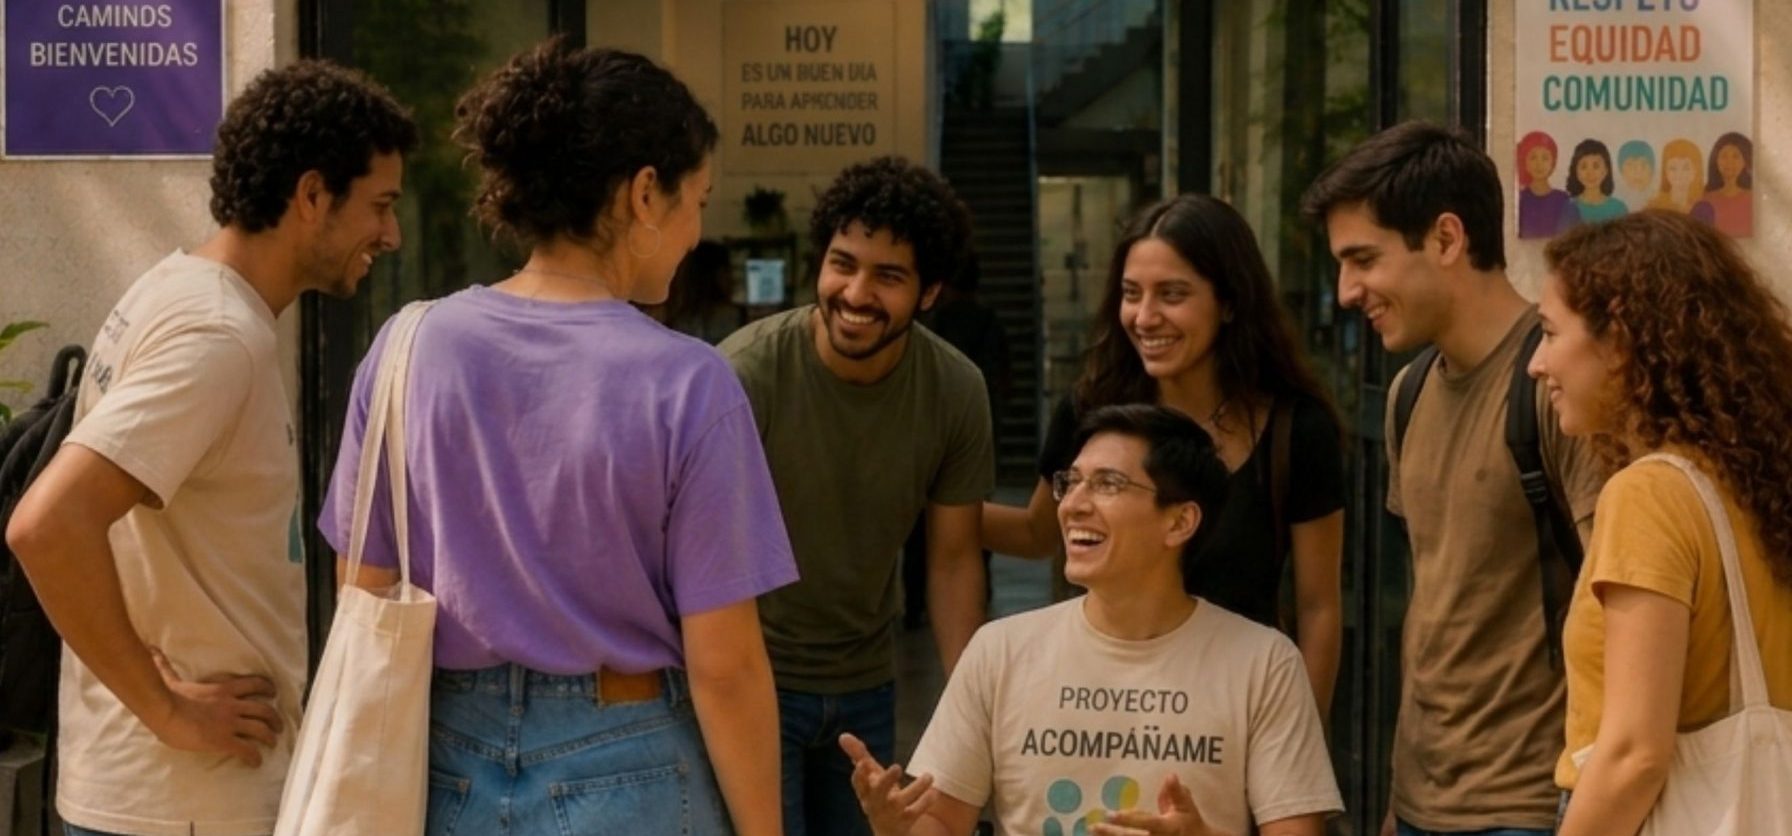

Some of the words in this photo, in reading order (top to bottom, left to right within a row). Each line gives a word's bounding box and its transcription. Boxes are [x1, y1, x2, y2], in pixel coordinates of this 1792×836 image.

[785, 25, 837, 52] HOY
[1550, 24, 1702, 64] EQUIDAD
[30, 41, 198, 67] BIENVENIDAS
[741, 62, 763, 82] ES
[741, 92, 786, 111] PARA
[1543, 75, 1729, 112] COMUNIDAD
[741, 122, 799, 147] ALGO
[804, 122, 877, 147] NUEVO
[1058, 686, 1189, 715] PROYECTO
